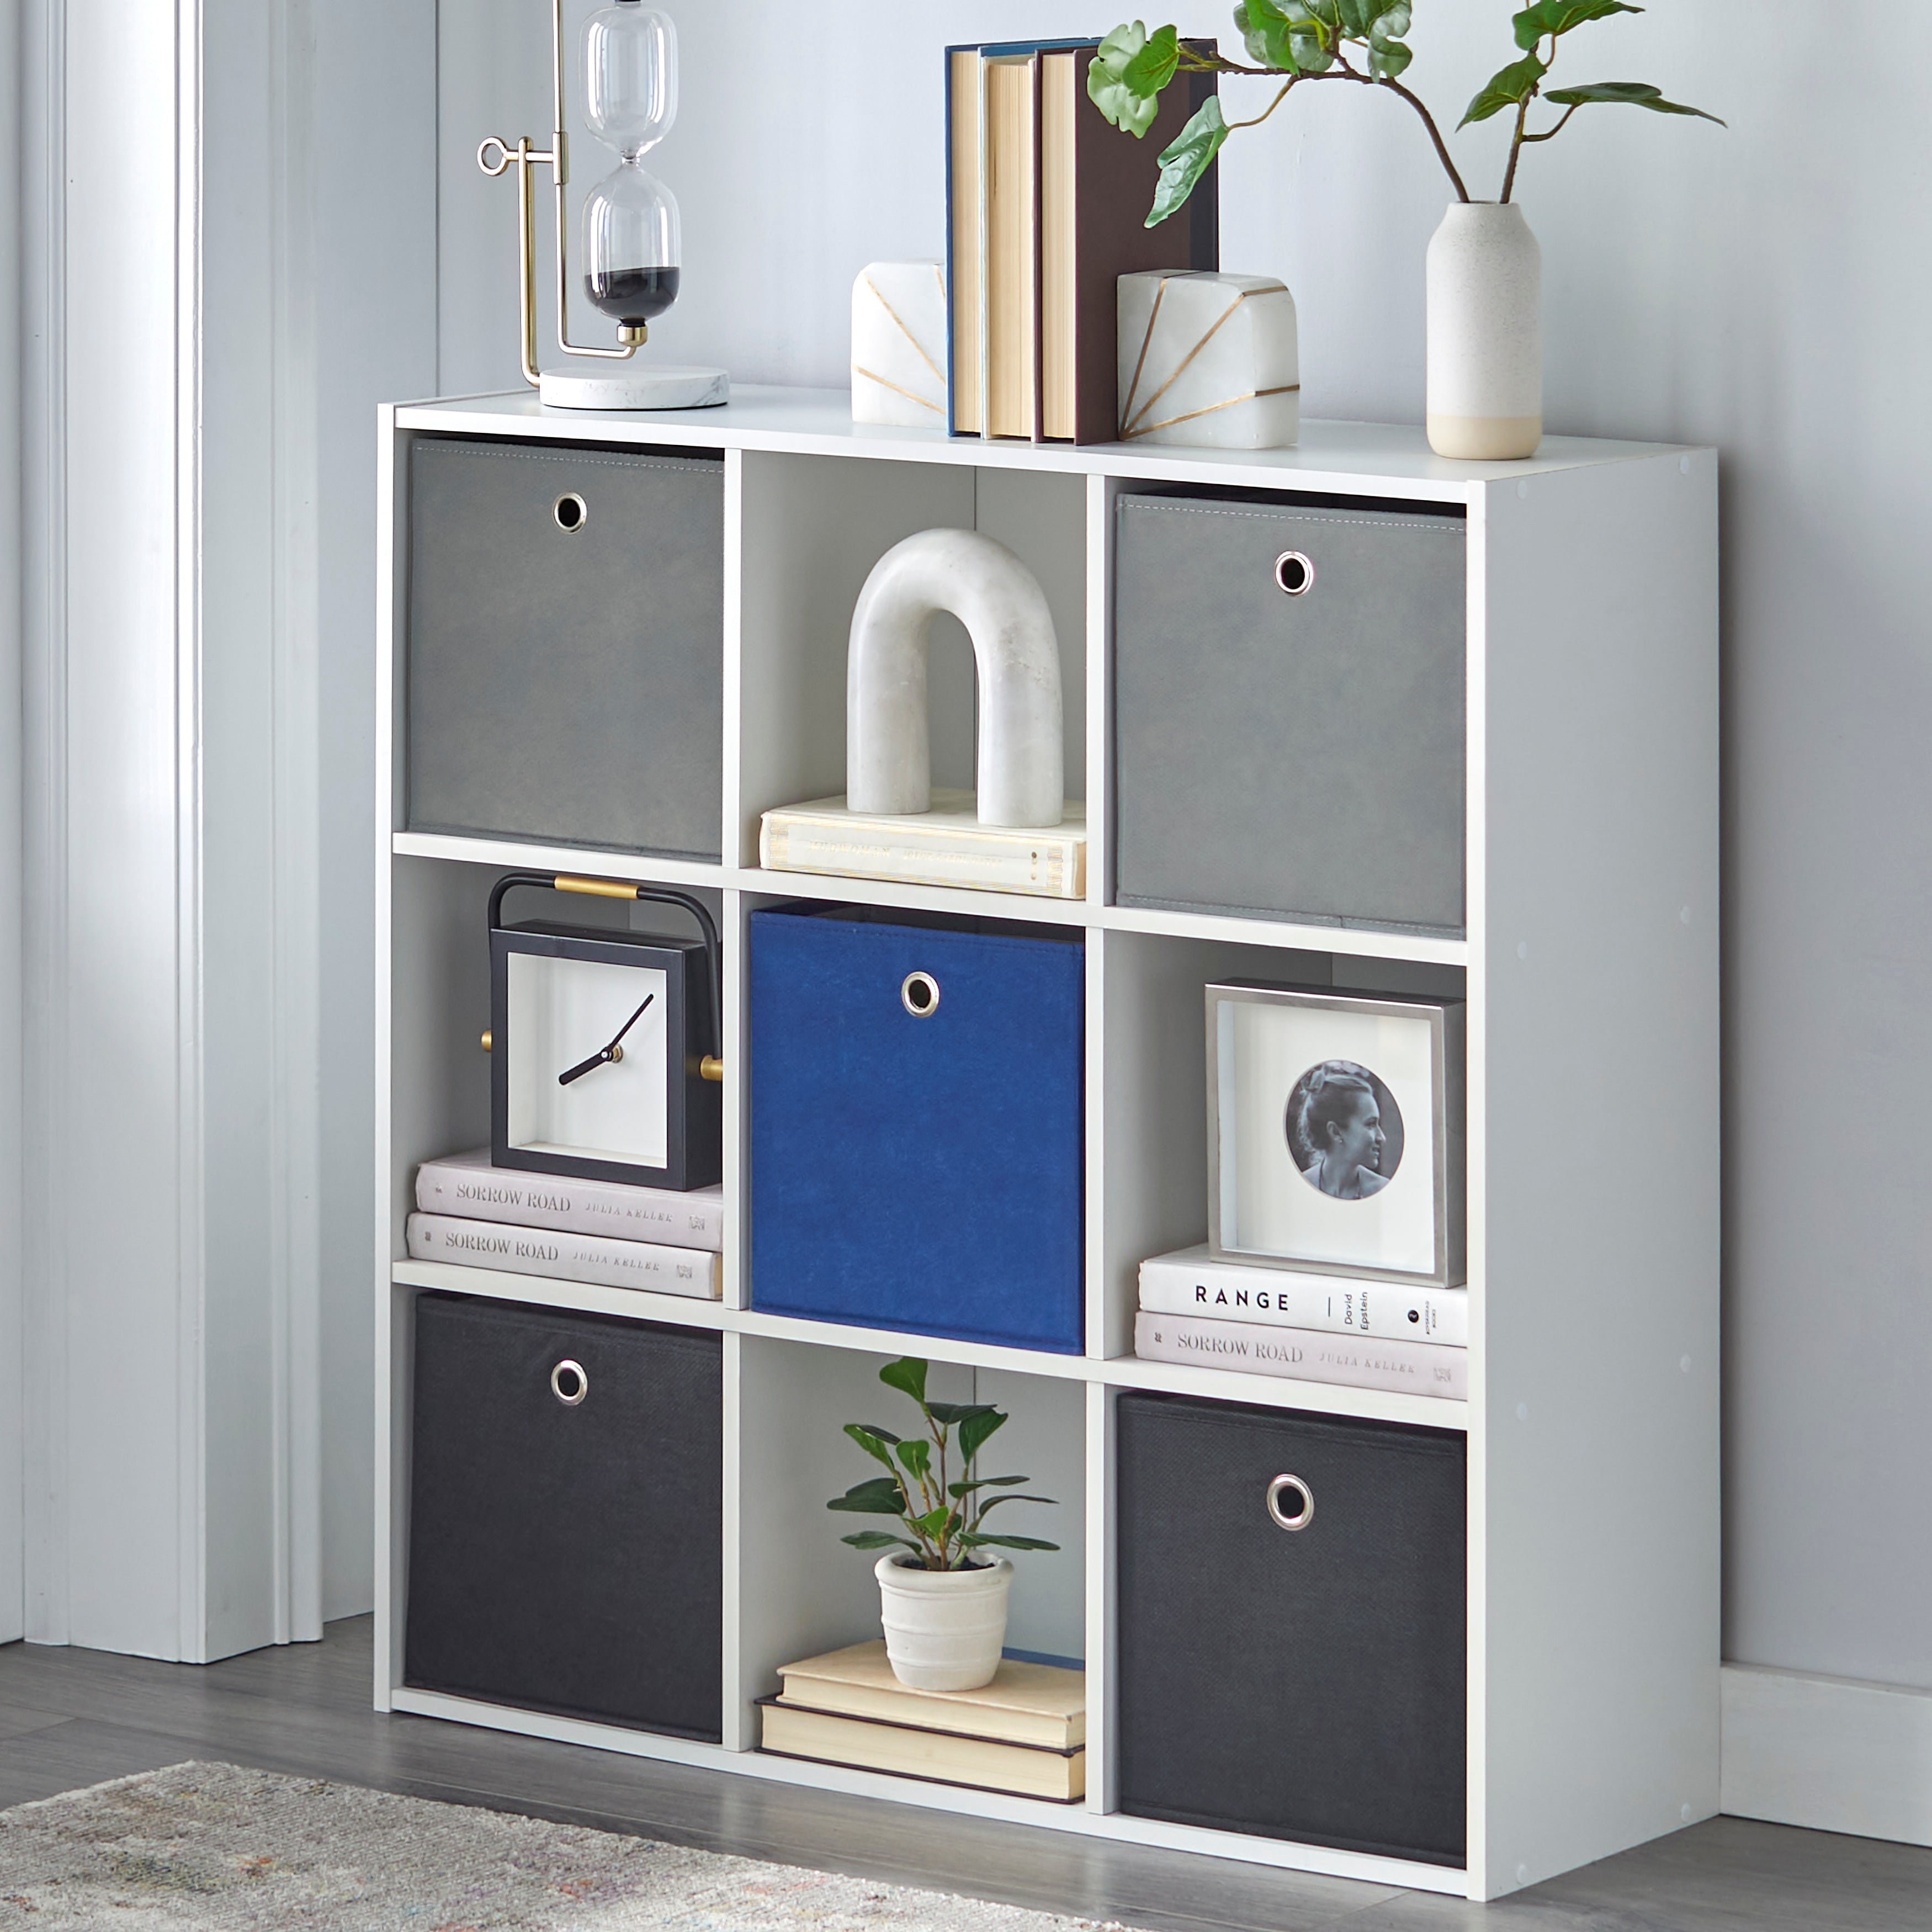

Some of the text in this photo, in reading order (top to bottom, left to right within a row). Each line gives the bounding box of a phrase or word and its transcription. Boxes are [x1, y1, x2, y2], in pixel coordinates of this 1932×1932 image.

[457, 1183, 522, 1205] SORROW
[528, 1192, 571, 1211] ROAD
[586, 1203, 620, 1215] JULIA
[445, 1232, 511, 1254] SORROW
[516, 1241, 558, 1260] ROAD
[574, 1252, 607, 1264] JULIA
[1196, 1285, 1288, 1310] RANGE
[1344, 1293, 1352, 1324] David
[1360, 1292, 1370, 1330] Epstein
[1177, 1334, 1249, 1356] SORROW
[1255, 1342, 1303, 1362] ROAD
[1319, 1353, 1357, 1366] JULIA
